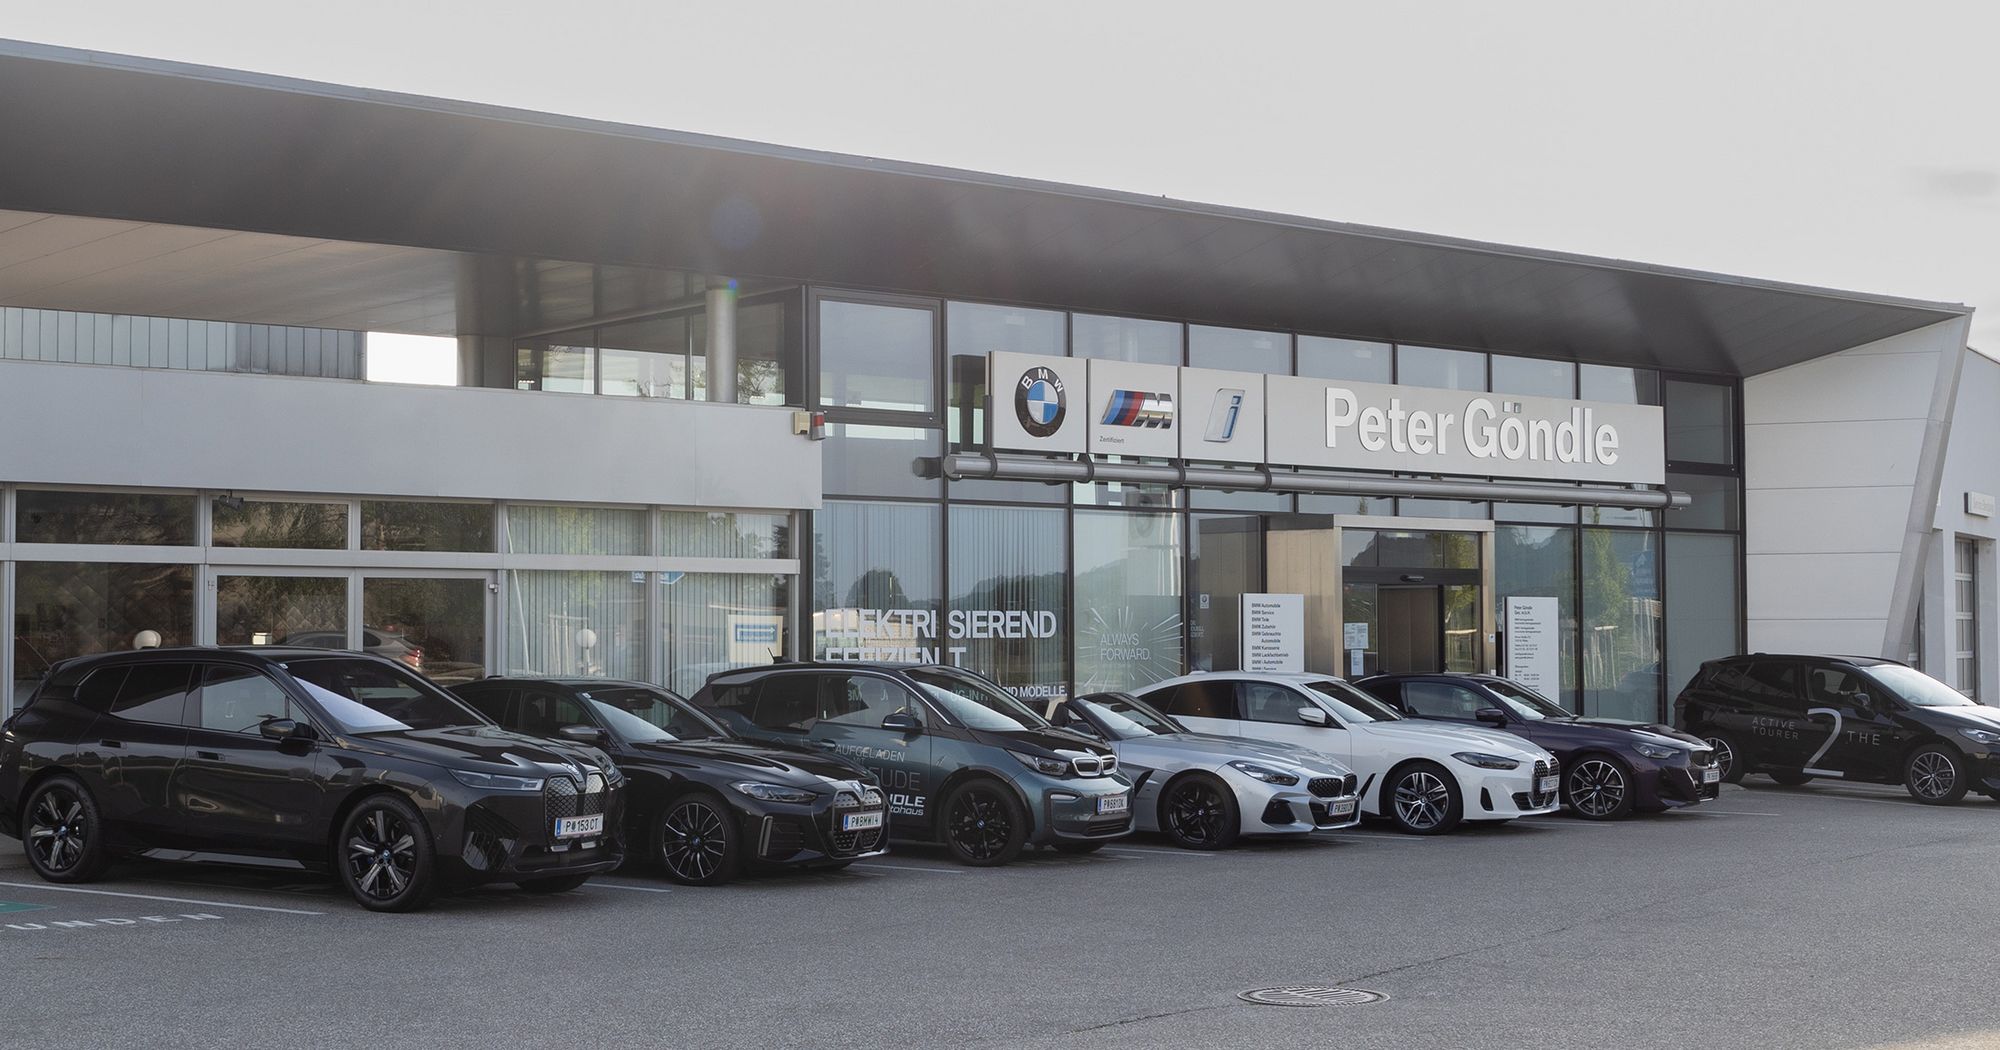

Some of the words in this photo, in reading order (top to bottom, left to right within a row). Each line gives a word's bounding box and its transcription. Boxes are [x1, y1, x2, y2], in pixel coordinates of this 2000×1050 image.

[1021, 368, 1064, 393] BMW
[1324, 386, 1454, 455] Peter
[1463, 397, 1619, 465] Göndle
[948, 610, 1057, 639] SIEREND
[1100, 632, 1140, 646] ALWAYS
[1752, 716, 1796, 730] ACTIVE
[1752, 726, 1799, 740] TOURER
[1802, 707, 1845, 777] 2
[1847, 730, 1880, 746] THE
[835, 744, 905, 762] AUFGELADEN
[0, 913, 225, 932] UNDEN
